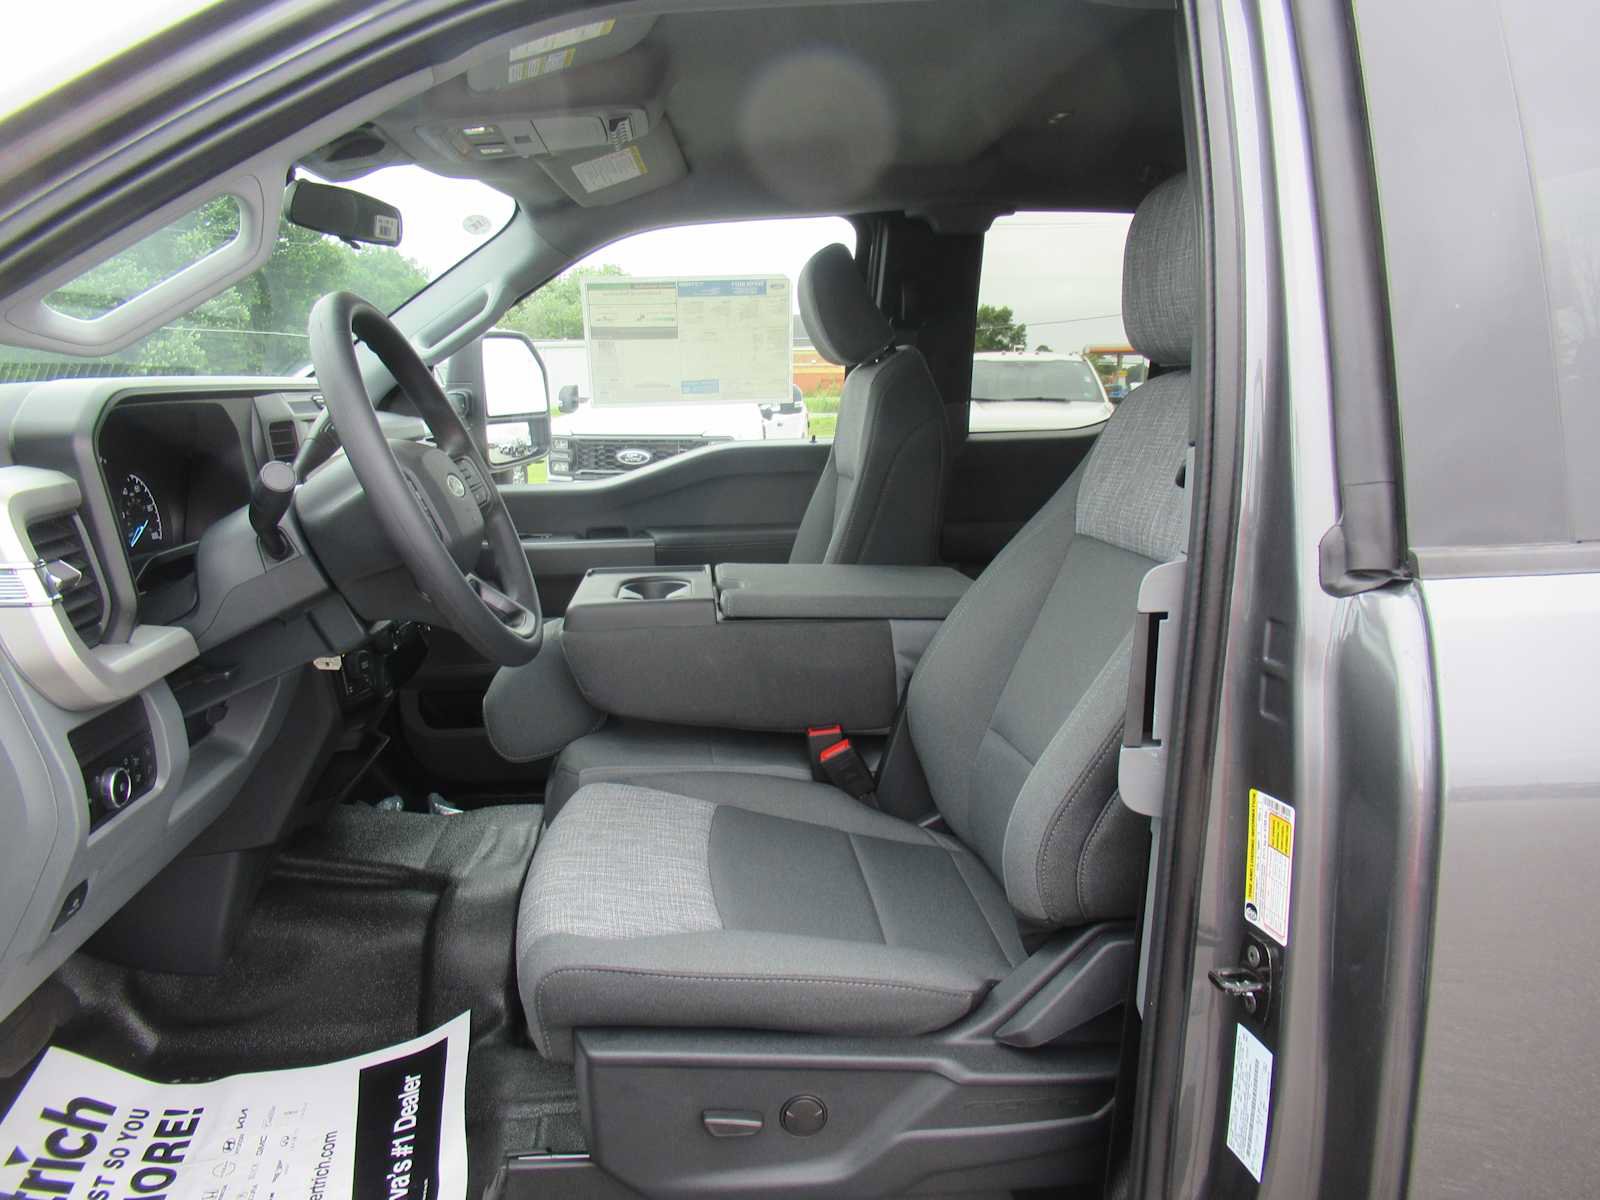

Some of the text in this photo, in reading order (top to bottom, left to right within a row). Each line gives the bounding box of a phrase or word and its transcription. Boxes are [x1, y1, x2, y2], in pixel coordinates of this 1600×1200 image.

[393, 1073, 422, 1133] Dealer
[87, 1108, 150, 1200] ST SO YOU
[390, 1133, 416, 1158] #1
